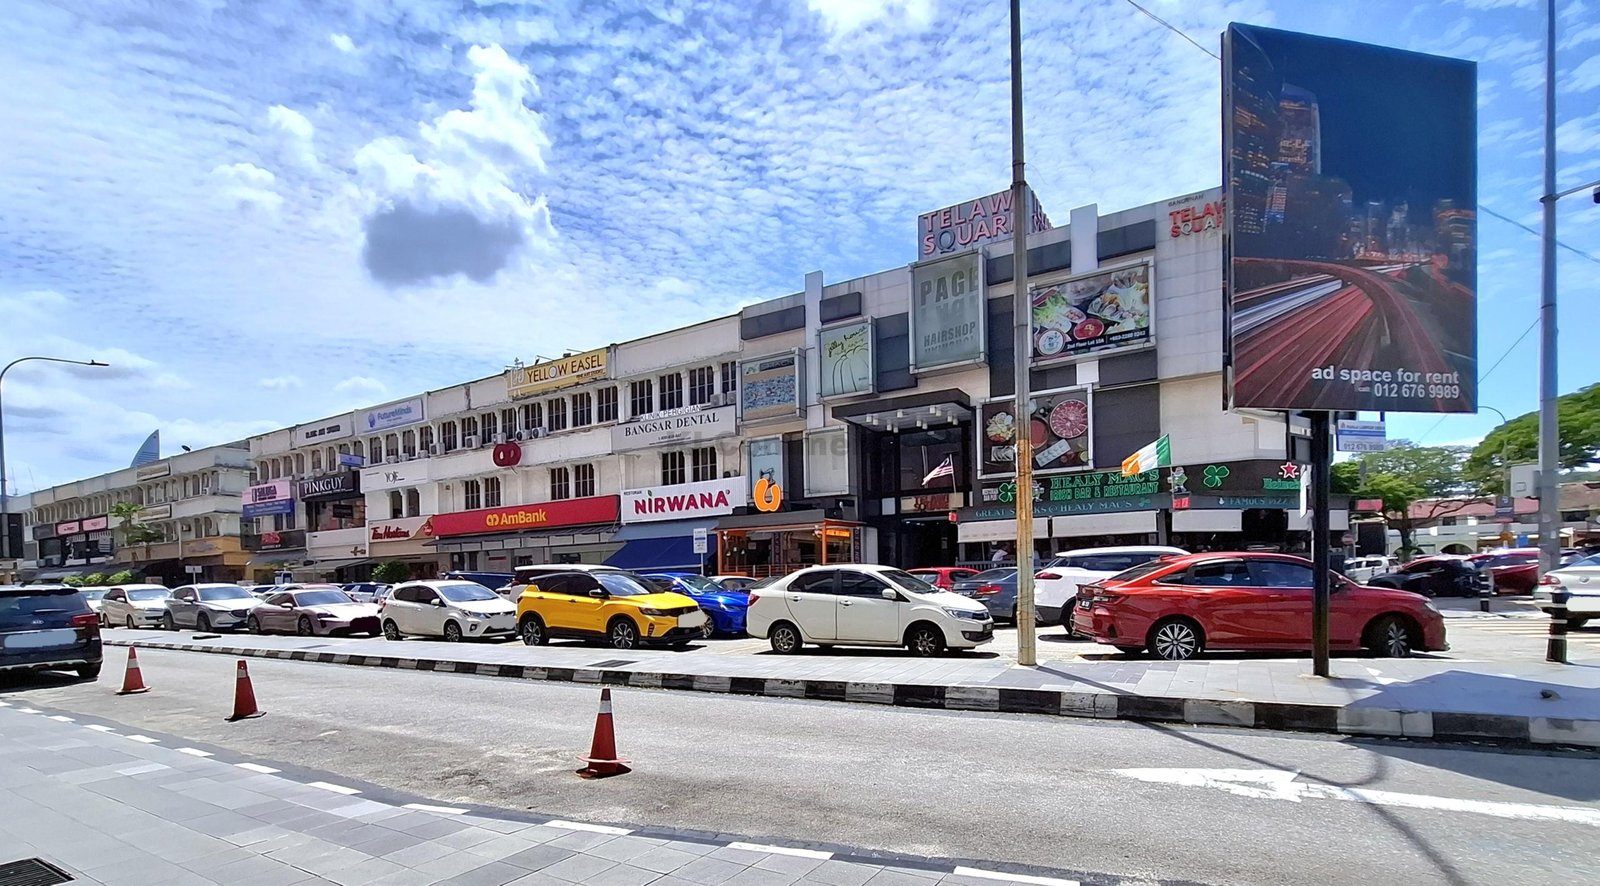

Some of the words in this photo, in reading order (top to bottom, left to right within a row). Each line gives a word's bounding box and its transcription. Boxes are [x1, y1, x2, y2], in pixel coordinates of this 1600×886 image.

[923, 192, 1015, 232] TELAW
[922, 213, 1014, 255] SQUAR
[920, 266, 979, 307] PAGE
[923, 321, 976, 347] HAIRSHOP
[527, 363, 568, 383] YELLOW
[570, 354, 603, 373] EASEL
[1311, 365, 1335, 380] ad
[1339, 368, 1392, 384] space
[1397, 368, 1421, 383] for
[1425, 371, 1460, 384] rent
[1374, 383, 1398, 398] 012
[1401, 384, 1426, 398] 676
[1428, 385, 1460, 399] 9989
[625, 421, 672, 437] BANGSAR
[676, 412, 720, 429] DENTAL
[303, 477, 344, 495] PINKGUY
[1050, 473, 1103, 489] HEALY
[1074, 487, 1092, 500] BAR
[1103, 481, 1159, 497] RESTAURANT
[634, 490, 729, 514] NIRWANA
[1009, 506, 1047, 515] SKS
[1060, 502, 1095, 512] HEALY
[1099, 500, 1132, 509] MAC'S
[500, 508, 547, 525] AmBank
[371, 526, 383, 540] Tim
